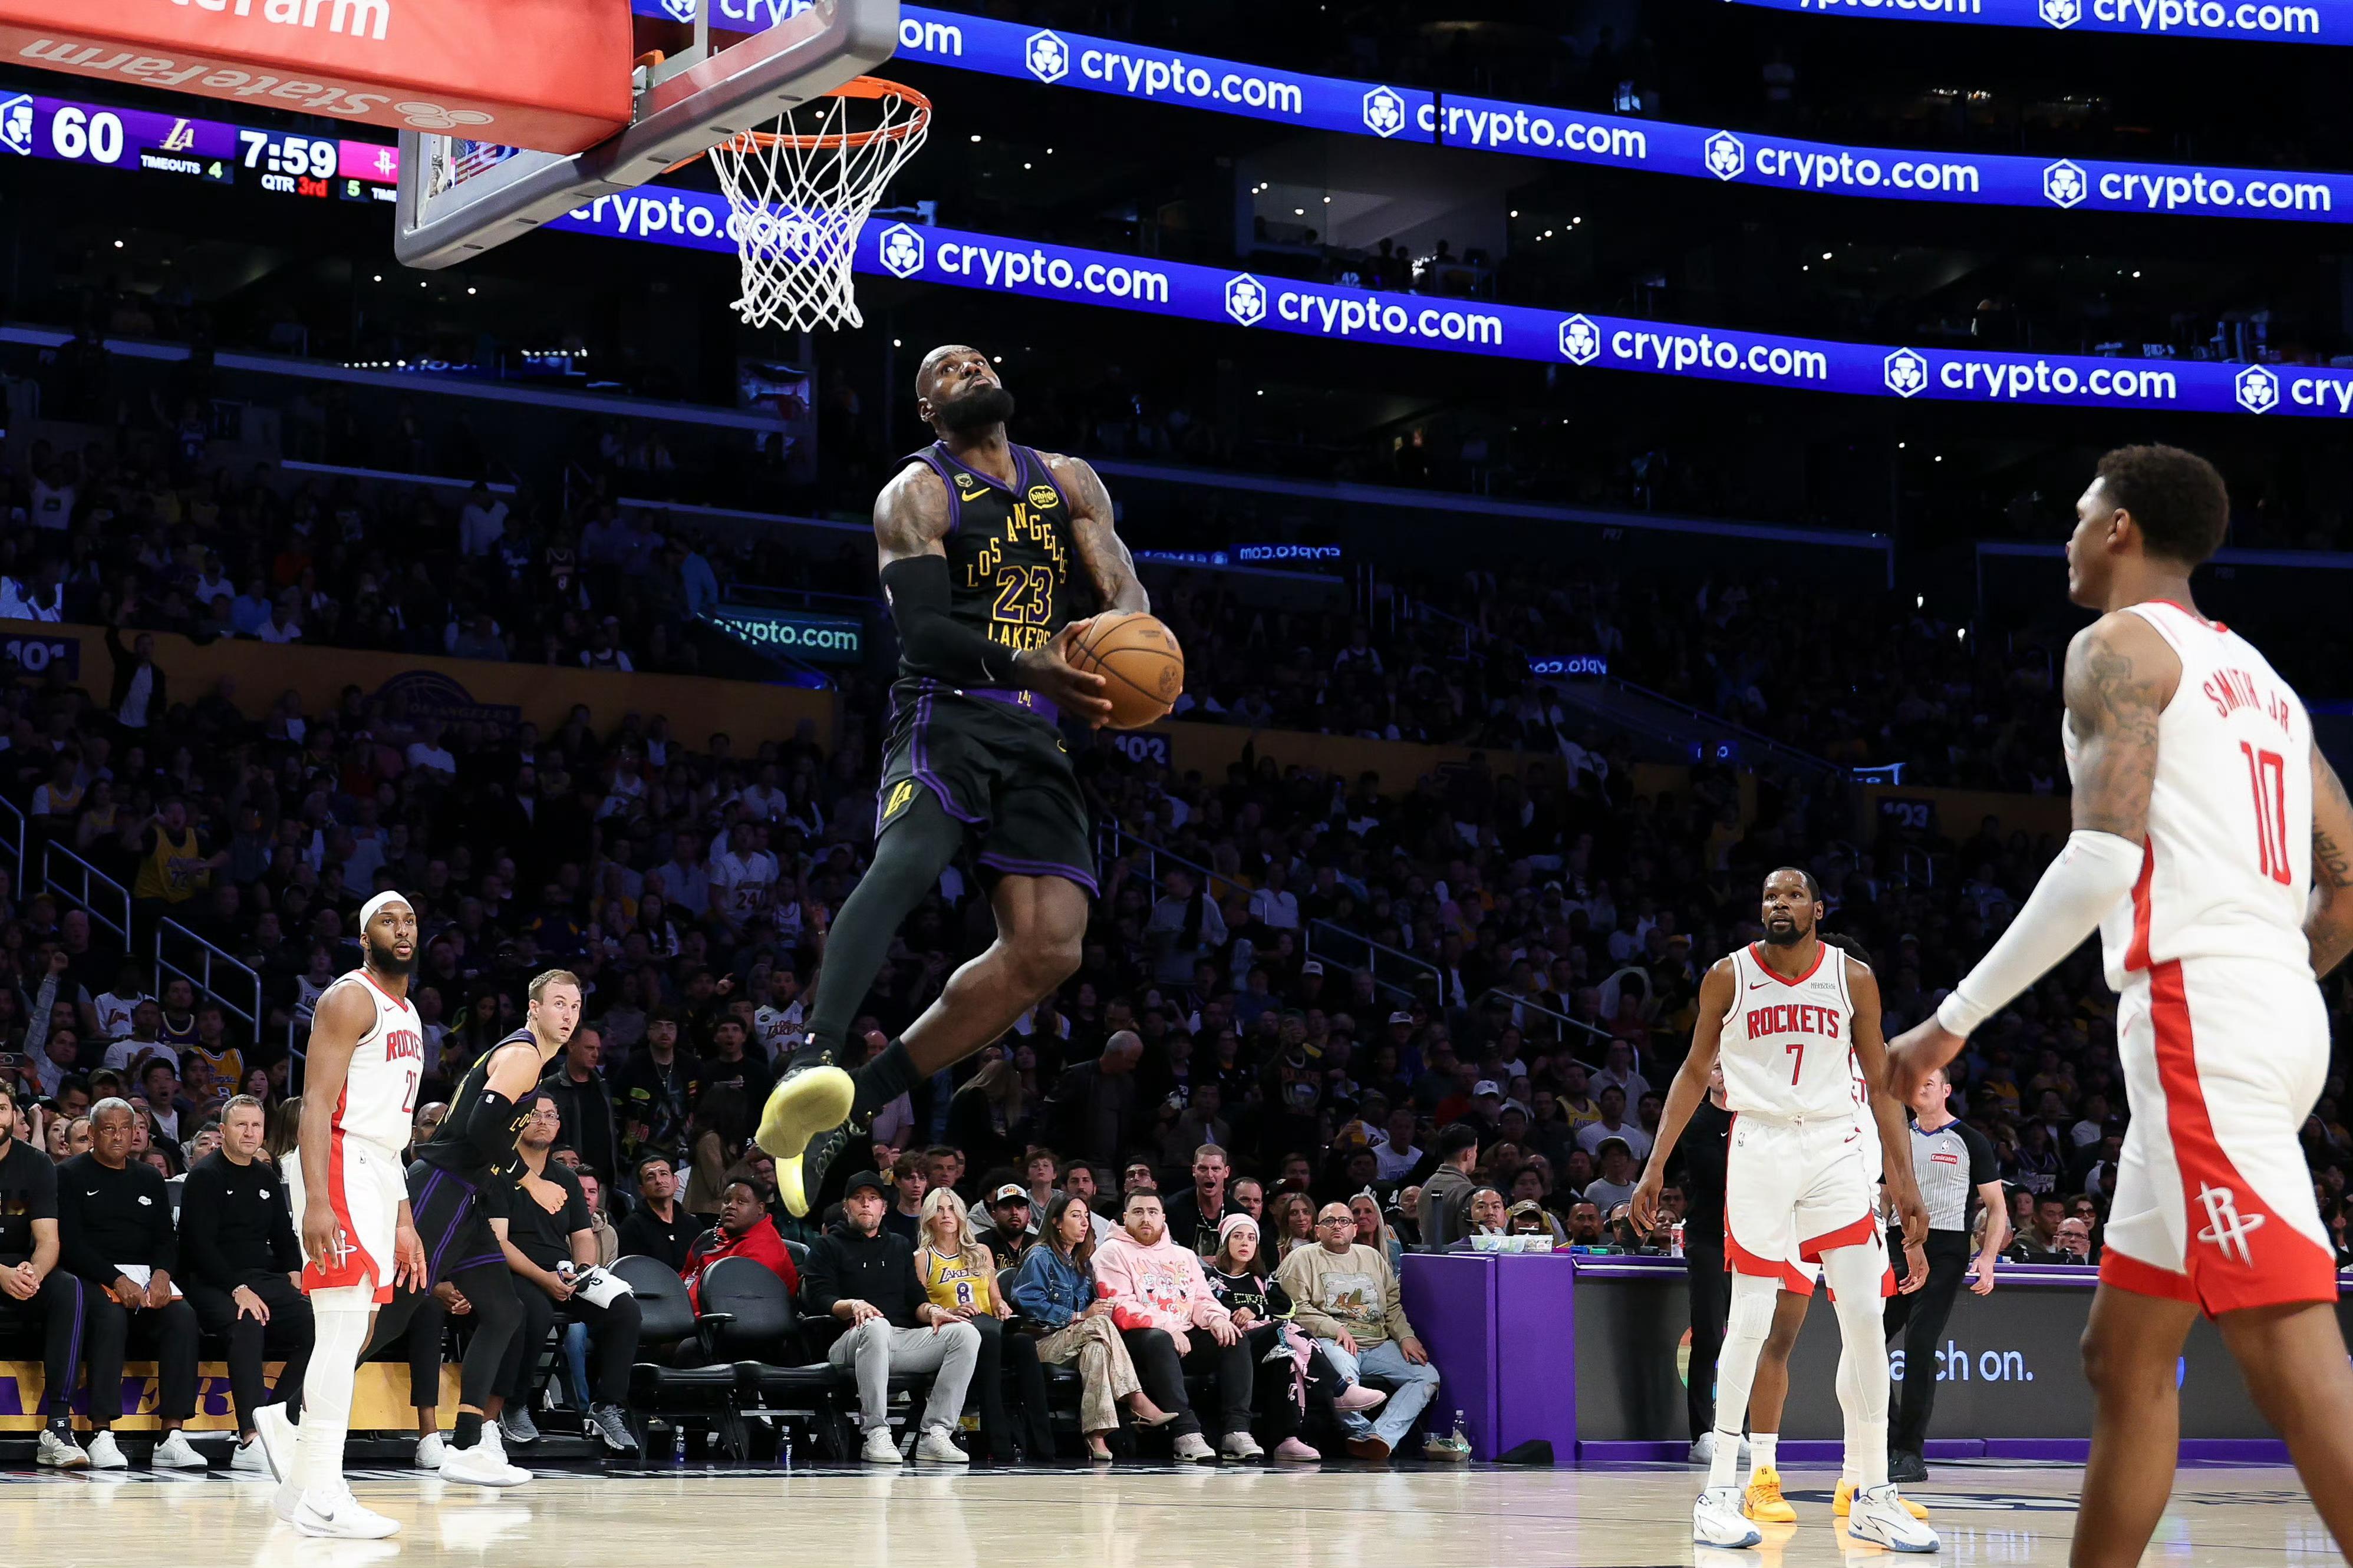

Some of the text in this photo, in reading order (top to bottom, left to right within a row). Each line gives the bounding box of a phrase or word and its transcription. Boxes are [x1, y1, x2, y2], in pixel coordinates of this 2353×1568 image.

[2093, 0, 2320, 34] crypto.com
[1080, 49, 1302, 114] crypto.com
[52, 107, 123, 163] 60
[1417, 104, 1646, 159] crypto.com
[140, 154, 223, 179] TIMEOUTS 4
[240, 130, 337, 177] 7:59
[1756, 147, 1979, 196] crypto.com
[261, 173, 328, 198] QTR 3rd
[347, 180, 361, 197] 5
[2100, 172, 2331, 212] crypto.com
[937, 243, 1168, 303] crypto.com
[1278, 292, 1502, 345] crypto.com
[1611, 331, 1827, 379] crypto.com
[1940, 360, 2177, 400] crypto.com
[967, 537, 1001, 587] LOS
[993, 564, 1054, 626] 23
[1017, 689, 1032, 707] LAL
[2239, 740, 2291, 886] 10
[736, 892, 757, 910] 24
[1746, 1003, 1840, 1041] ROCKETS
[1785, 1044, 1805, 1086] 7
[1931, 1154, 1957, 1163] Emirates
[955, 1281, 973, 1305] 8
[1979, 1349, 2034, 1381] on.
